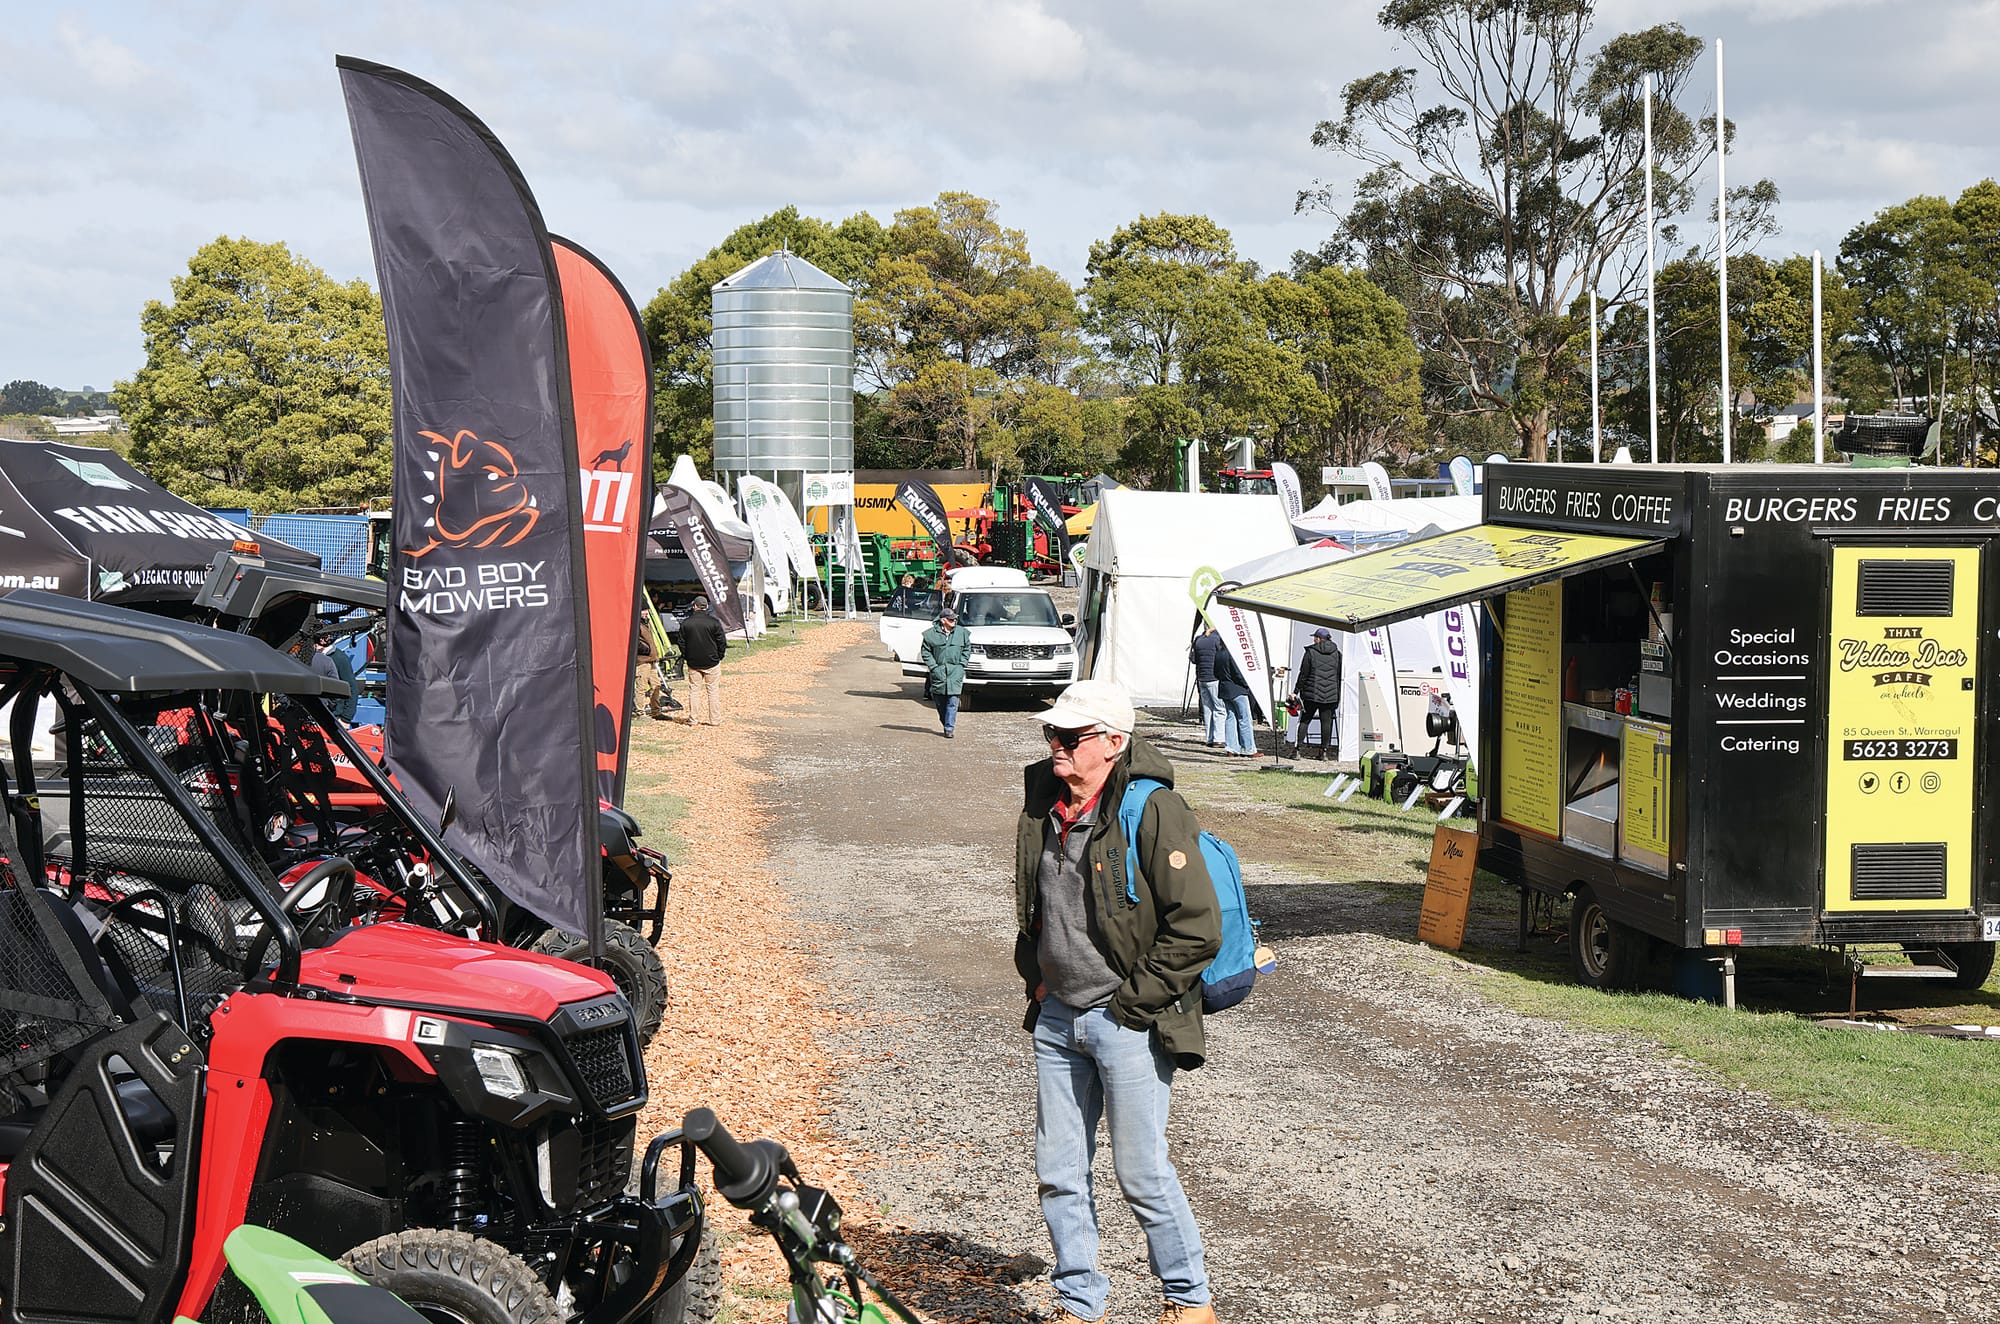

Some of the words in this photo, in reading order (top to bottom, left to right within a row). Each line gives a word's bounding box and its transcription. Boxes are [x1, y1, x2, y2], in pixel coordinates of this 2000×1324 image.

[903, 485, 947, 535] TRULINE
[1029, 483, 1062, 529] TRULINE
[1499, 486, 1557, 516] BURGERS
[1565, 491, 1601, 519] FRIES
[1611, 494, 1671, 524] COFFEE
[1725, 498, 1858, 522] BURGERS
[1877, 497, 1951, 522] FRIES
[1973, 497, 2000, 522] C
[54, 505, 167, 534] FARM
[149, 510, 253, 541] SHEDS
[688, 515, 729, 603] statewide
[172, 572, 182, 585] OF
[403, 565, 467, 590] BAD
[478, 560, 546, 585] BOY
[400, 584, 549, 614] MOWERS
[1729, 627, 1796, 646] Special
[1889, 628, 1918, 638] THAT
[1445, 611, 1468, 680] ECG
[1839, 639, 1910, 672] Yellow
[1914, 639, 1968, 670] Door
[1714, 649, 1810, 667] Occasions
[1881, 672, 1924, 683] CAFE
[1715, 692, 1807, 712] Weddings
[1893, 684, 1924, 701] wheels
[1843, 727, 1857, 736] 85
[1861, 727, 1895, 738] Queen
[1914, 726, 1961, 738] Warragul
[1720, 735, 1800, 755] Catering
[1851, 740, 1899, 758] 5623
[1904, 740, 1950, 758] 3273
[1443, 839, 1464, 860] Menu
